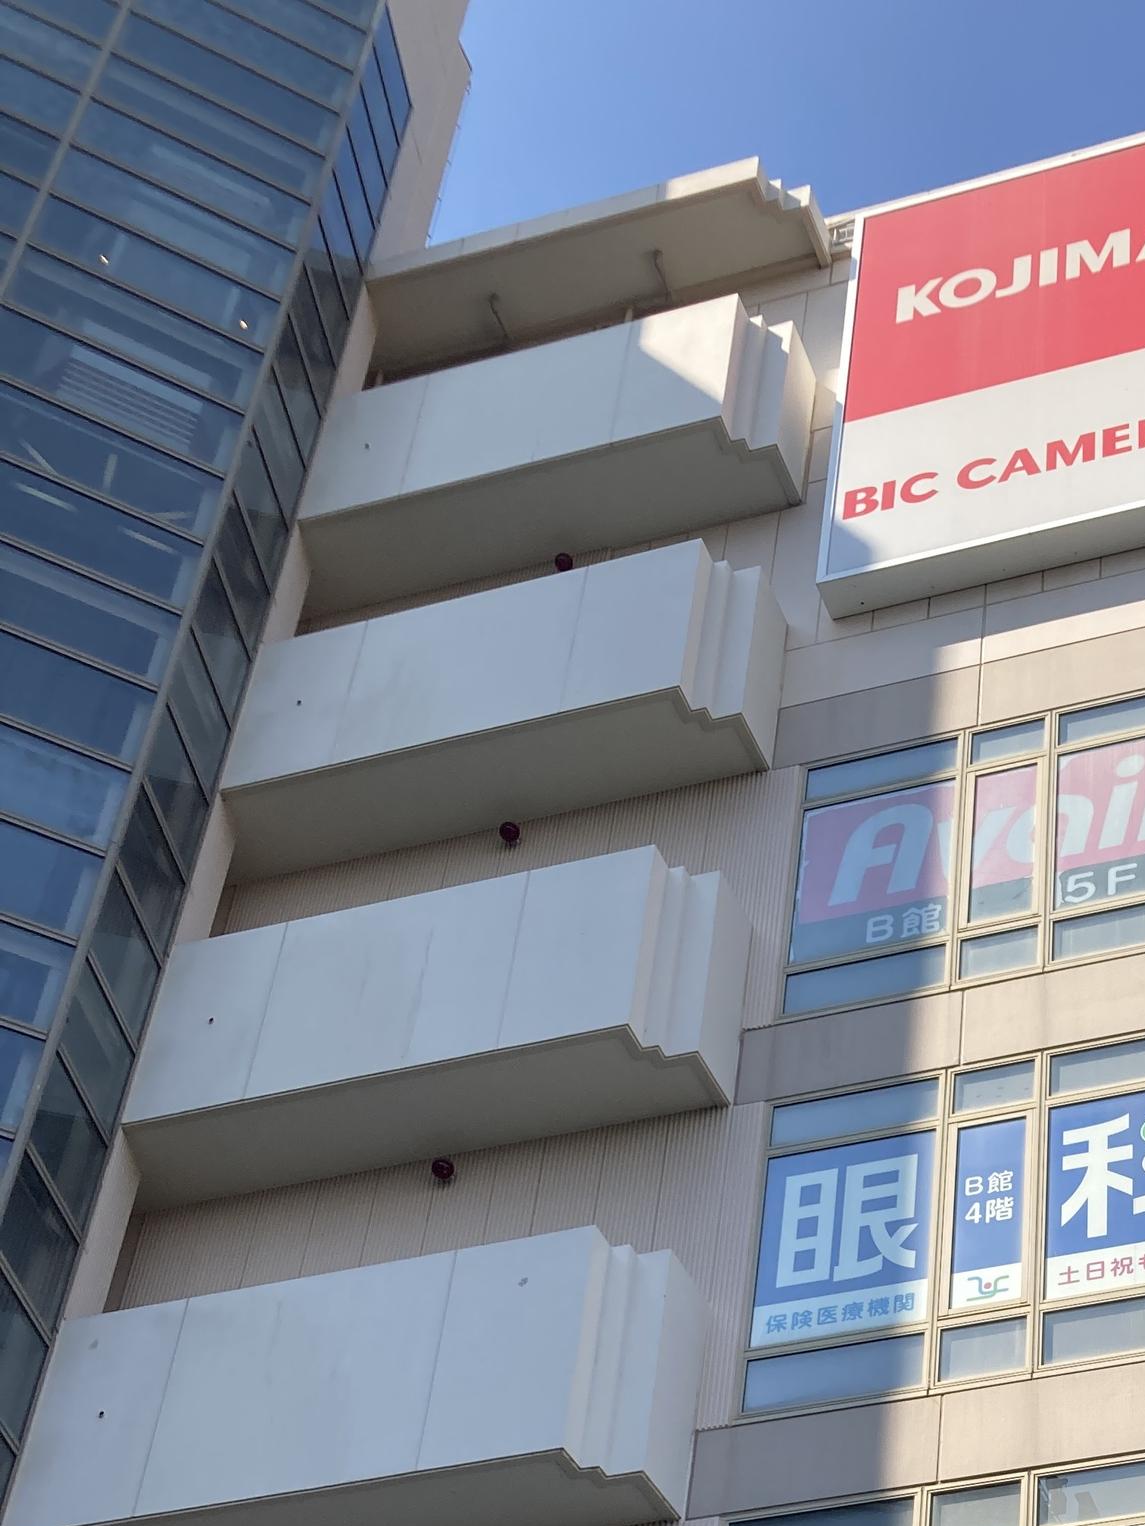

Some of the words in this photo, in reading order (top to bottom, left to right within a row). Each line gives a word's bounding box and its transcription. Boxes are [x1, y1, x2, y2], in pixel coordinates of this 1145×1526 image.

[842, 472, 938, 520] BIC
[865, 902, 945, 943] B館
[1064, 862, 1138, 903] 5F
[965, 1170, 1014, 1196] B館
[965, 1196, 1014, 1224] 4階
[766, 1292, 915, 1334] 保険医療機関
